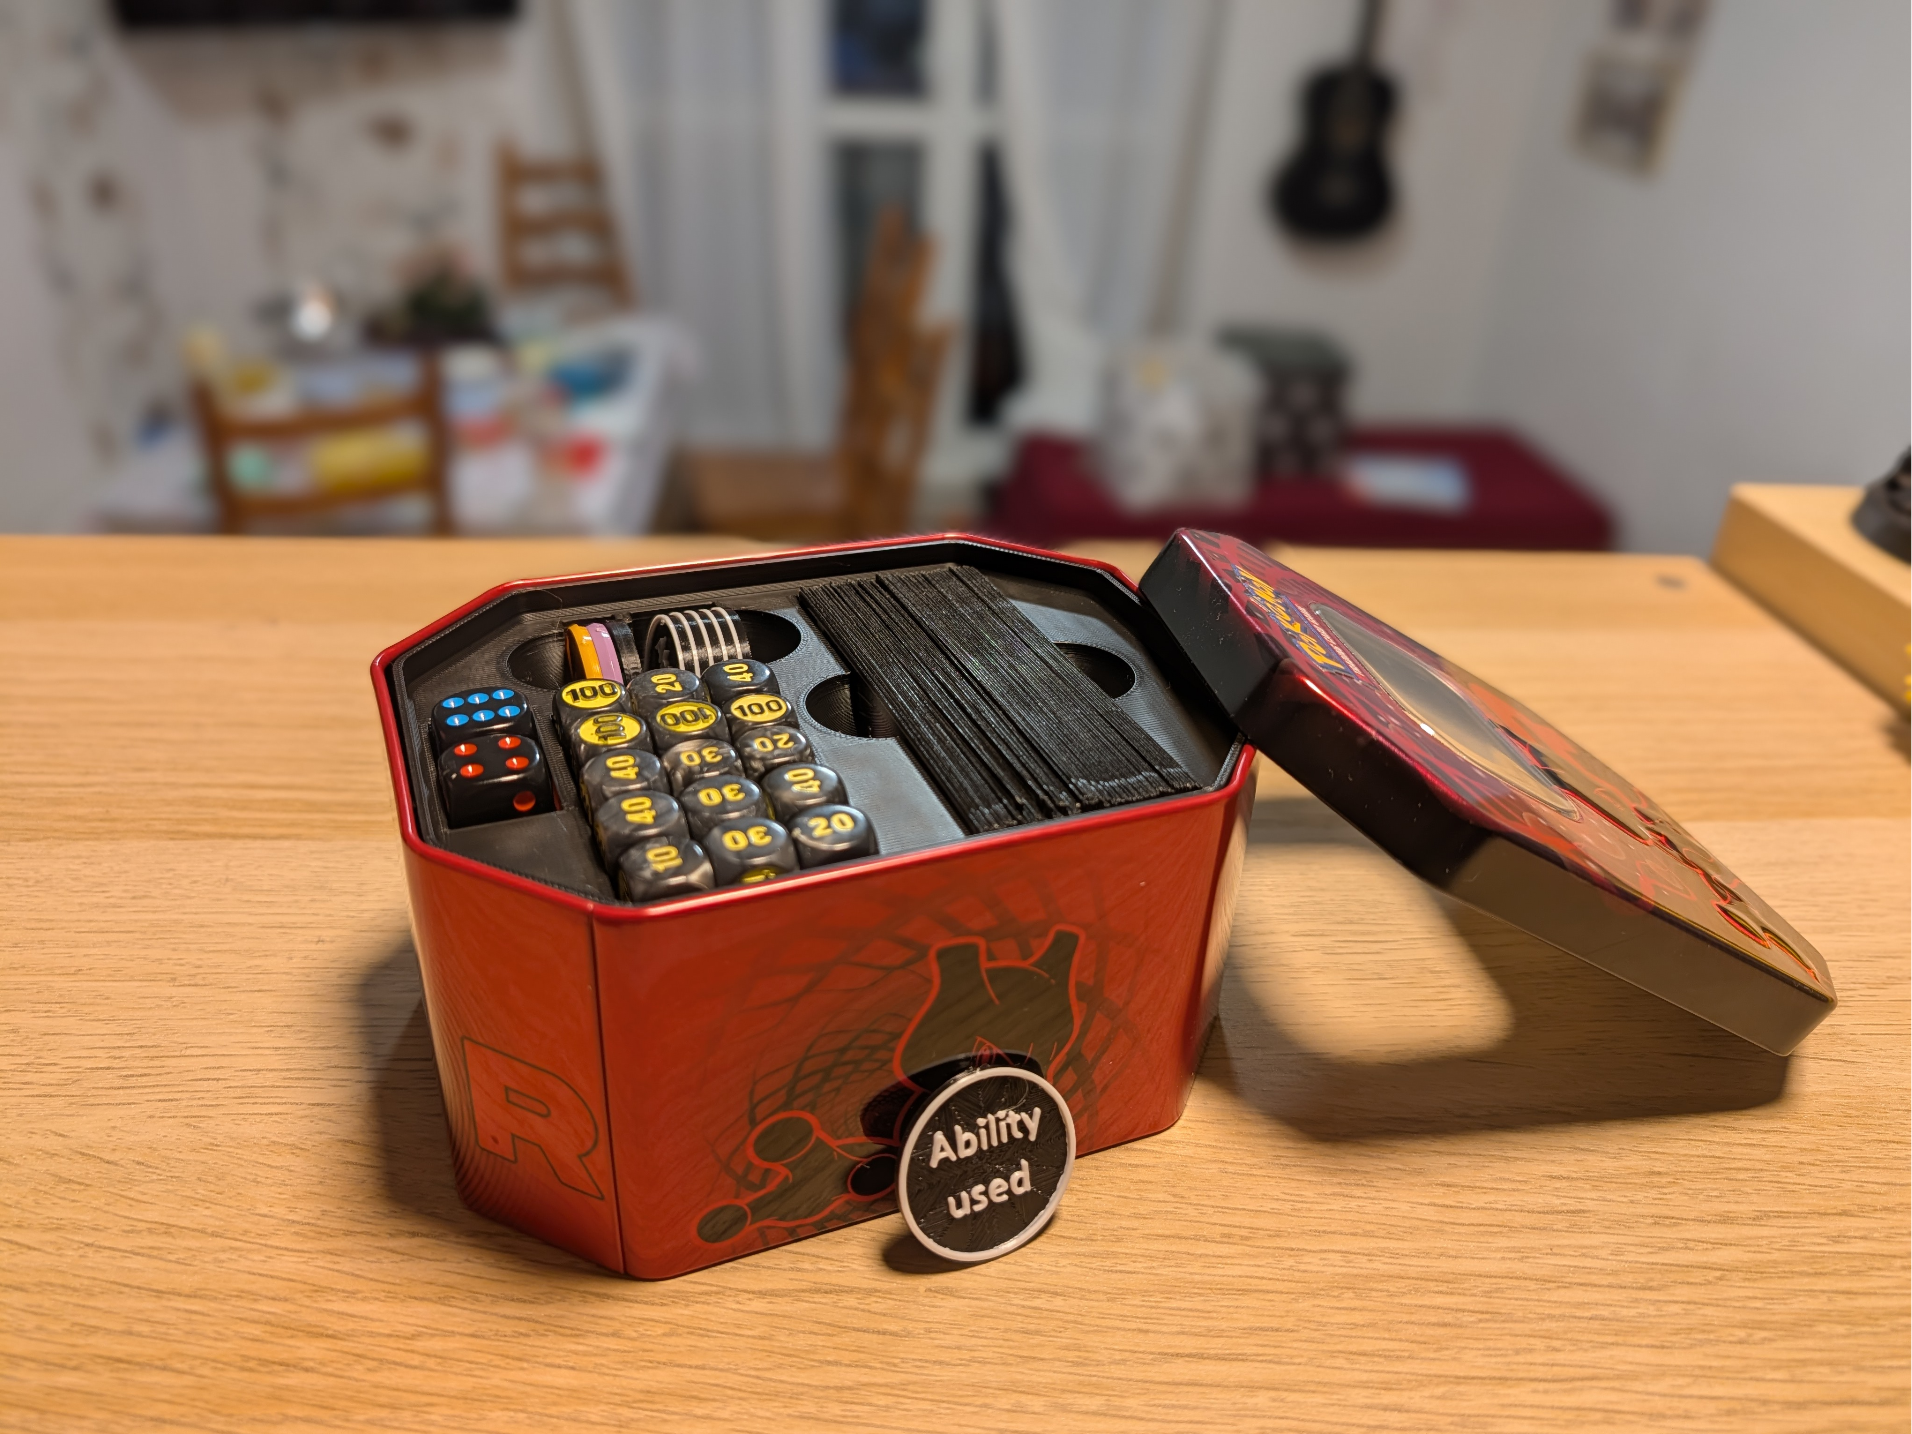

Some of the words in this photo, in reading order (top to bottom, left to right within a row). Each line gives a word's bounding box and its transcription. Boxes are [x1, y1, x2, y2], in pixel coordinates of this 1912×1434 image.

[651, 673, 683, 694] 20
[723, 663, 753, 682] 40
[565, 682, 618, 703] 100
[660, 706, 713, 727] 100
[733, 699, 783, 717] 100
[593, 714, 627, 745] 100
[754, 732, 795, 752] 20
[606, 755, 639, 779] 40
[680, 746, 723, 767] 30
[784, 767, 822, 794] 40
[697, 783, 746, 807] 30
[620, 796, 656, 825] 40
[807, 812, 855, 838] 20
[721, 825, 773, 851] 30
[645, 845, 684, 874] 10
[460, 1034, 605, 1201] R
[929, 1106, 1041, 1169] Ability
[947, 1158, 1031, 1219] used
